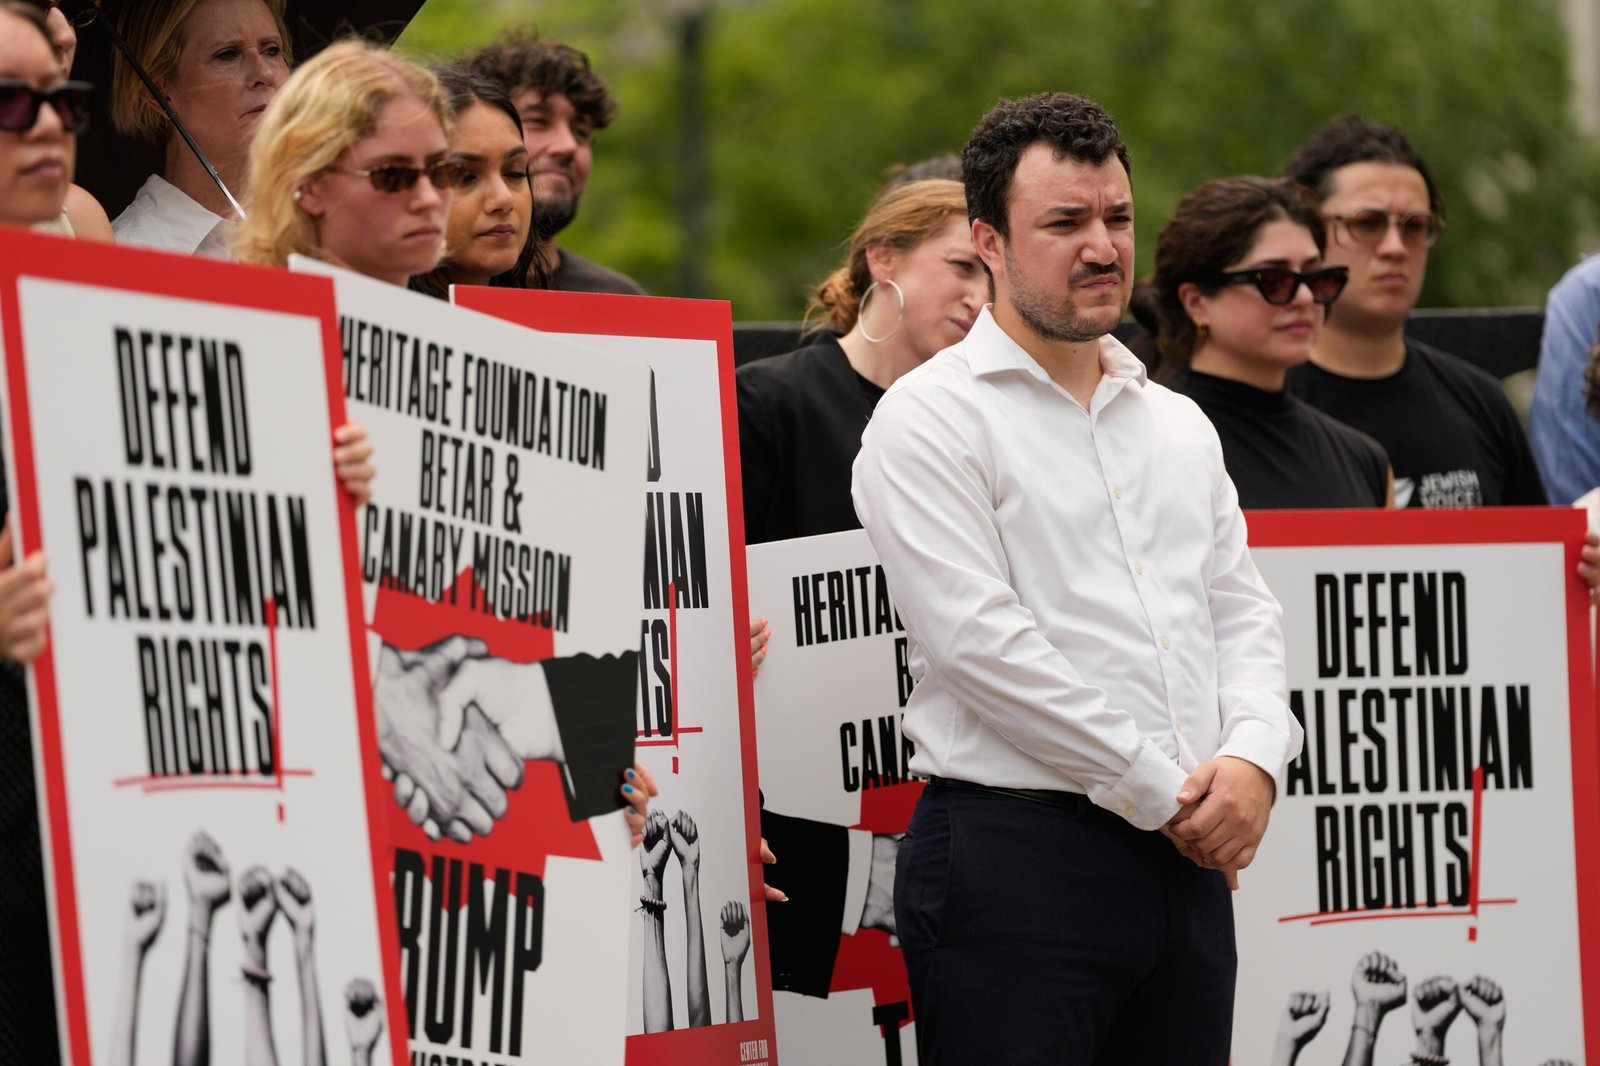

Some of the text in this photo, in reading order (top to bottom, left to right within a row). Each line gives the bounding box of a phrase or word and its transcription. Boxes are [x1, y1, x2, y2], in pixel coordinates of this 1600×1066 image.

[114, 327, 252, 477] DEFEND
[341, 315, 453, 427] HERITAGE
[462, 352, 607, 472] FOUNDATION
[420, 430, 523, 534] BETAR &
[1421, 469, 1479, 491] JEWISH
[74, 475, 316, 630] PALESTINIAN
[363, 504, 571, 634] CANARY MISSION
[792, 564, 906, 647] HERITA
[1315, 571, 1468, 678] DEFEND
[1286, 684, 1534, 796] ALESTINIAN
[393, 847, 545, 1058] RUMP
[740, 1041, 759, 1061] CENTER
